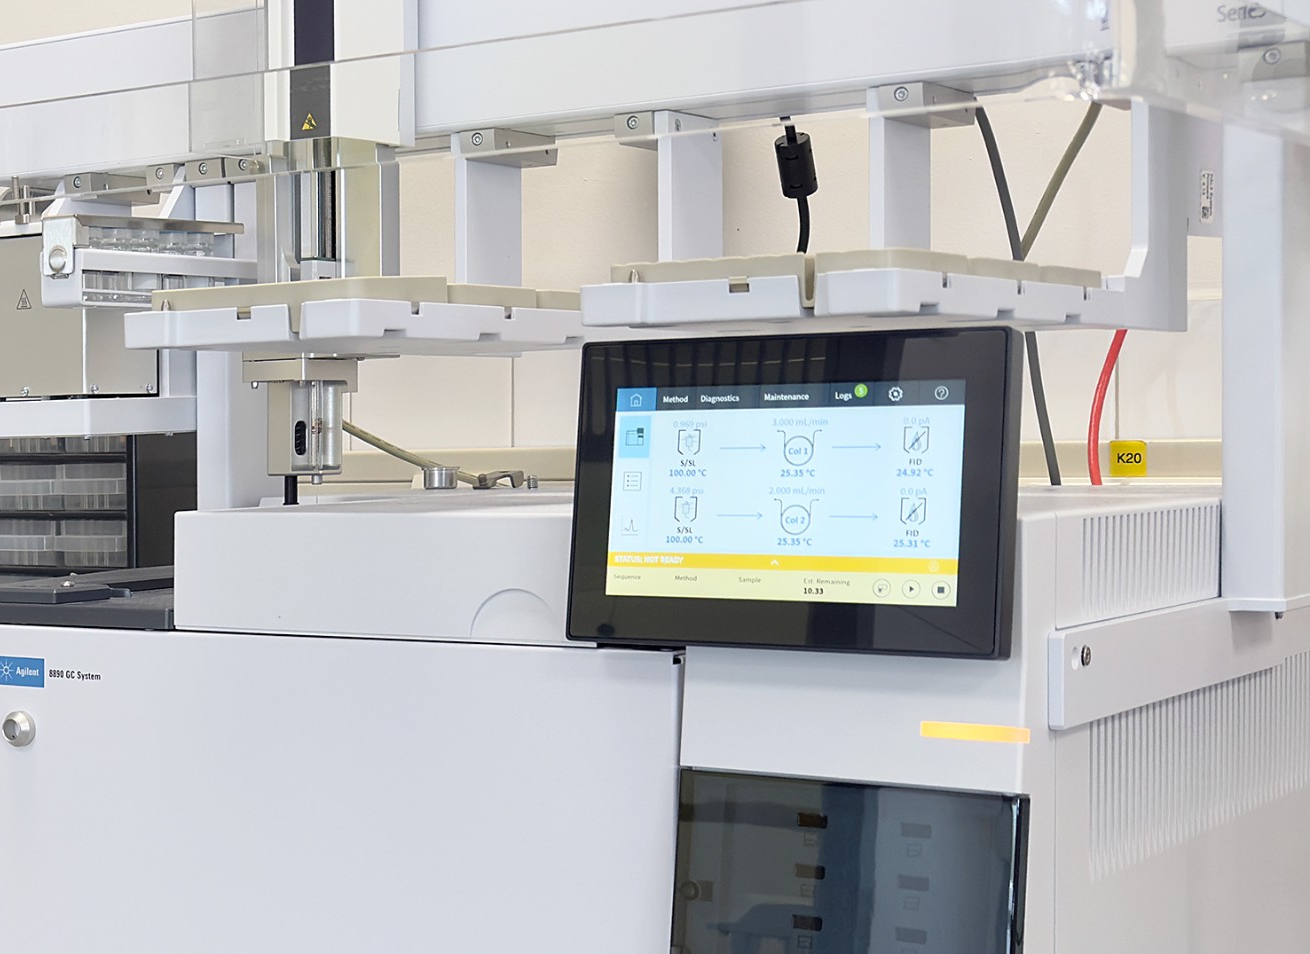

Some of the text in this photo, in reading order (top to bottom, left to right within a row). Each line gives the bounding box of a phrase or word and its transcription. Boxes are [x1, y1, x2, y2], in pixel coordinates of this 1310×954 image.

[663, 391, 853, 403] Method Diagnostics Maintenance Logs
[772, 417, 828, 427] 3.000 mL/min
[788, 446, 802, 456] Col
[908, 458, 922, 466] FID
[1117, 452, 1142, 464] K20
[669, 469, 696, 478] 100.00
[780, 469, 804, 478] 25.35
[896, 469, 922, 477] 24.92
[769, 486, 825, 496] 2.000 mL/min
[785, 516, 799, 525] Col
[905, 529, 920, 538] FID
[666, 535, 693, 544] 100.00
[777, 537, 801, 546] 25.35
[893, 539, 918, 548] 25.31
[644, 556, 659, 564] NOT
[660, 556, 684, 565] READY
[613, 573, 641, 581] Sequence
[674, 574, 698, 582] Method
[738, 576, 762, 584] Sample
[816, 578, 850, 587] Remaining
[15, 666, 39, 677] Agilent
[49, 669, 101, 681] 8890 GC System
